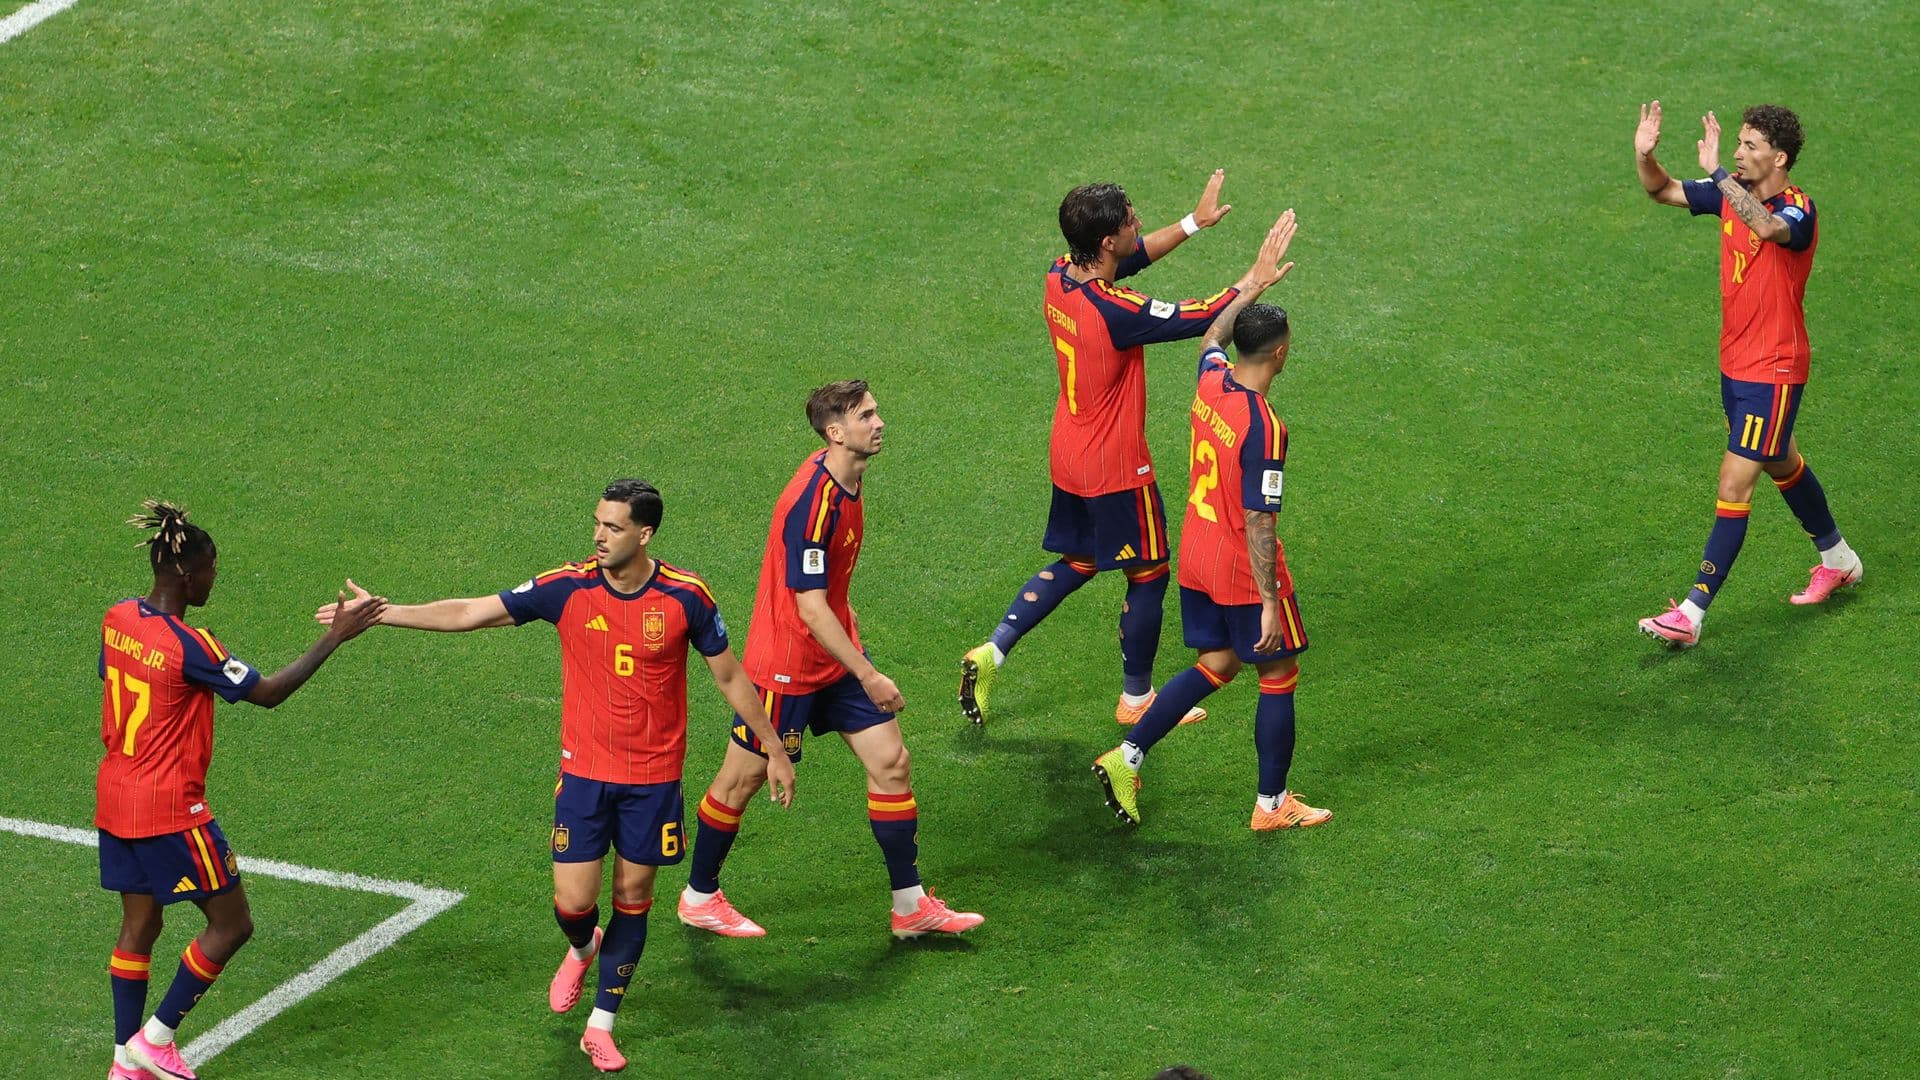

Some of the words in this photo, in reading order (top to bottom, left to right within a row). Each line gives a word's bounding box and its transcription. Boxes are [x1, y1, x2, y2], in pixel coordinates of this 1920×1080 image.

[1047, 303, 1078, 337] FERRAN
[1056, 335, 1078, 416] 7
[1191, 398, 1212, 423] DRO
[1740, 413, 1765, 451] 11
[104, 625, 144, 661] WILLIAMS
[142, 649, 166, 672] JR.
[614, 643, 635, 677] 6
[106, 665, 151, 757] 17
[660, 822, 679, 857] 6
